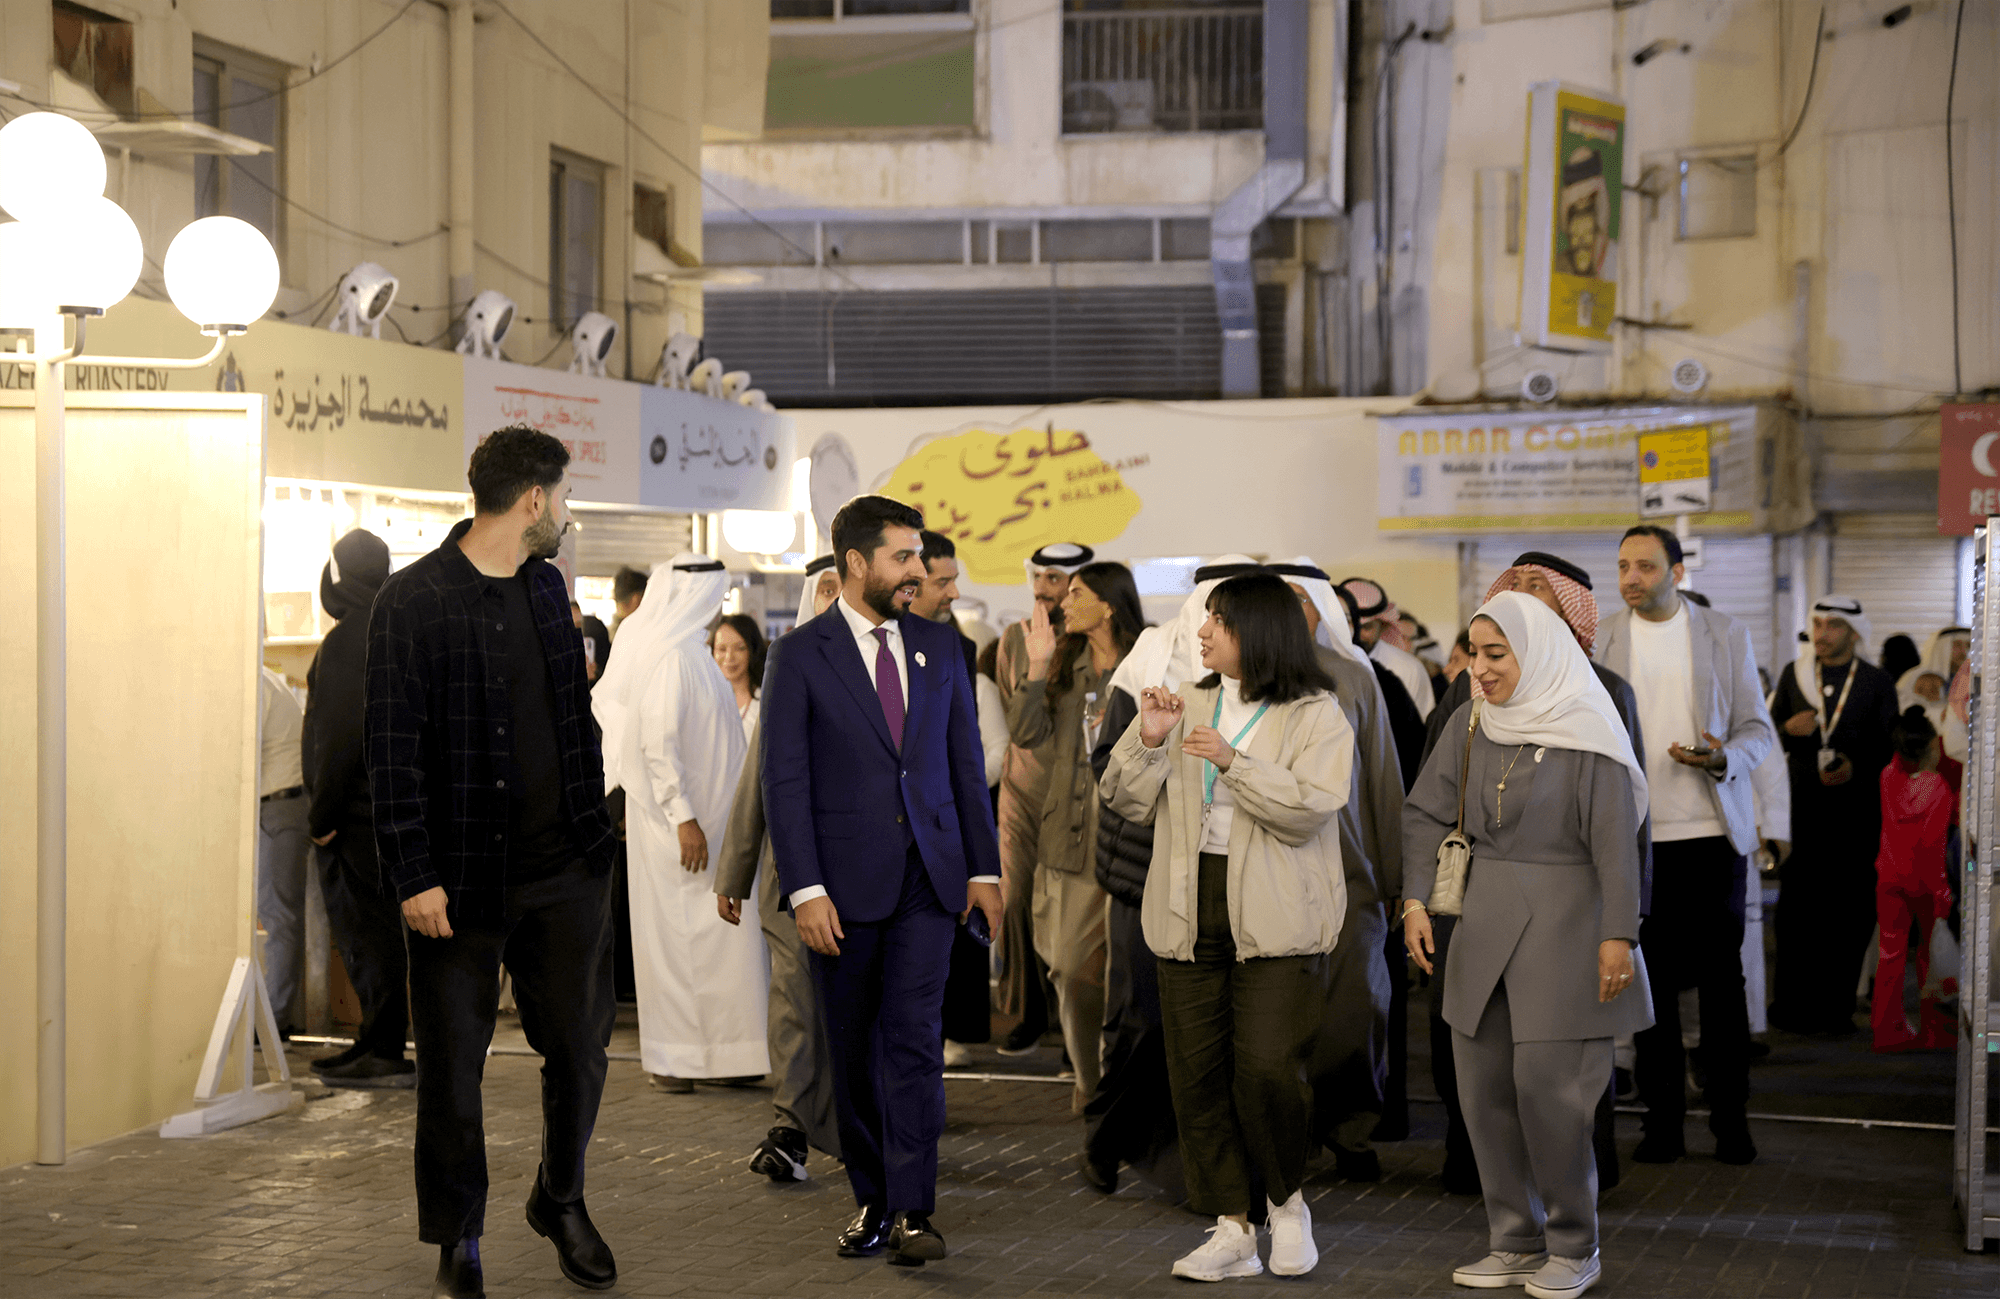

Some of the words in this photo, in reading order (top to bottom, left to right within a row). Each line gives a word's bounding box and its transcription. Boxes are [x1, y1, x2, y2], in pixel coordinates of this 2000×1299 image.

[274, 369, 351, 432] الجزيرة
[358, 375, 448, 432] محمصة
[959, 419, 1091, 480] حلوى
[1398, 427, 1512, 456] ABRAR
